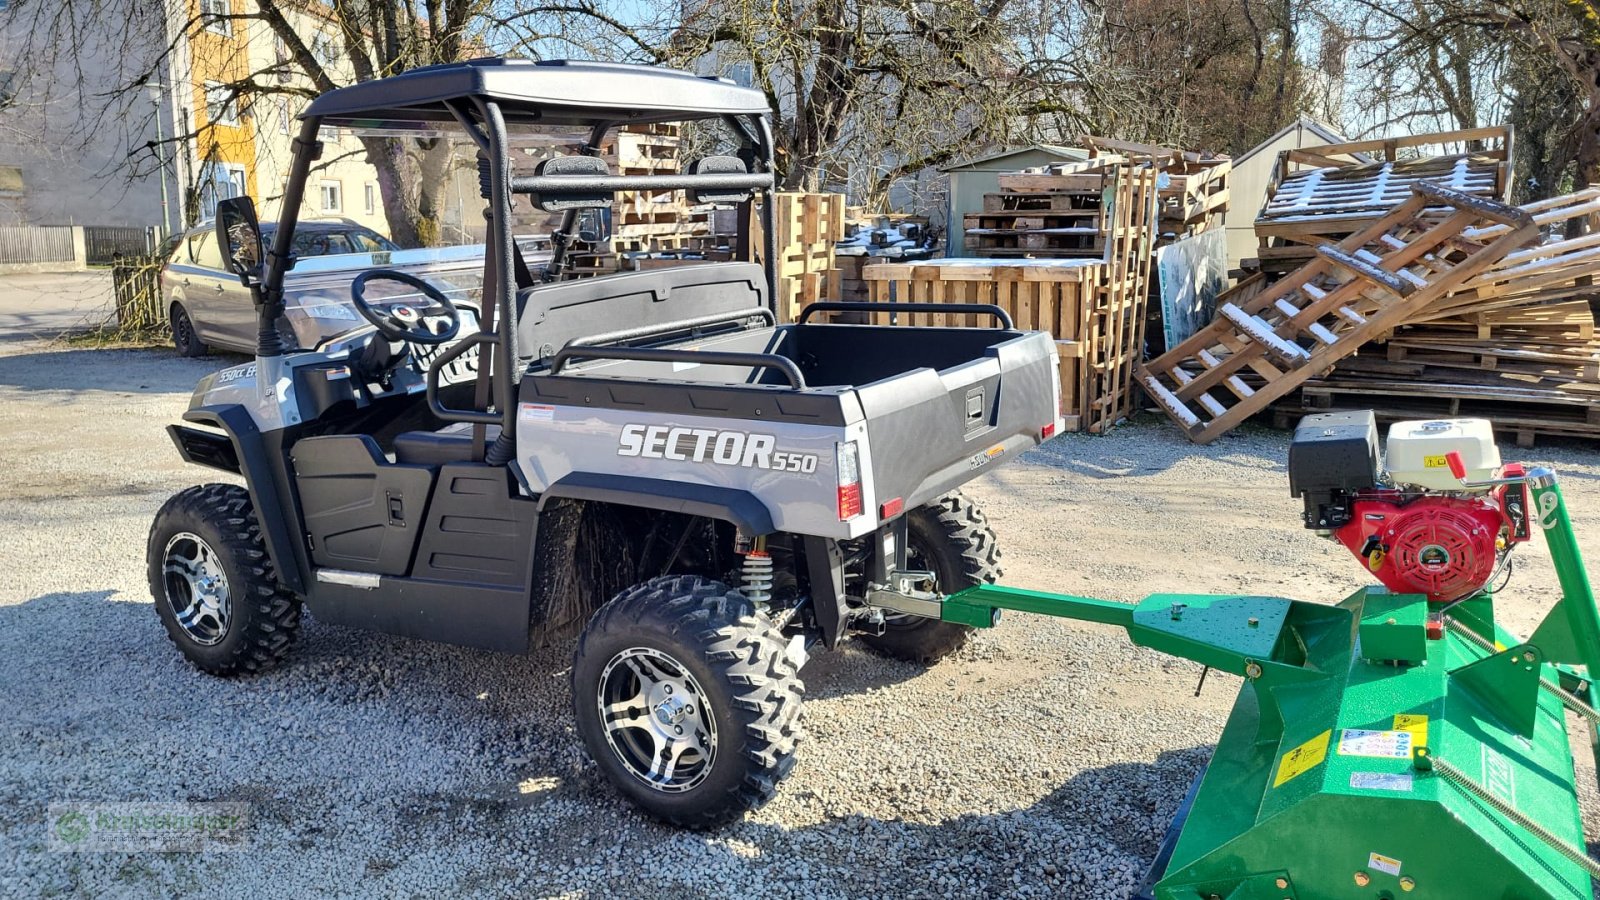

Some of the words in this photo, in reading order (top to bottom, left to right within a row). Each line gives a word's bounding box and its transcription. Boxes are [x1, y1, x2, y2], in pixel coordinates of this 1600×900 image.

[219, 368, 246, 383] 550cc
[617, 423, 776, 469] SECTOR
[771, 452, 818, 474] 550
